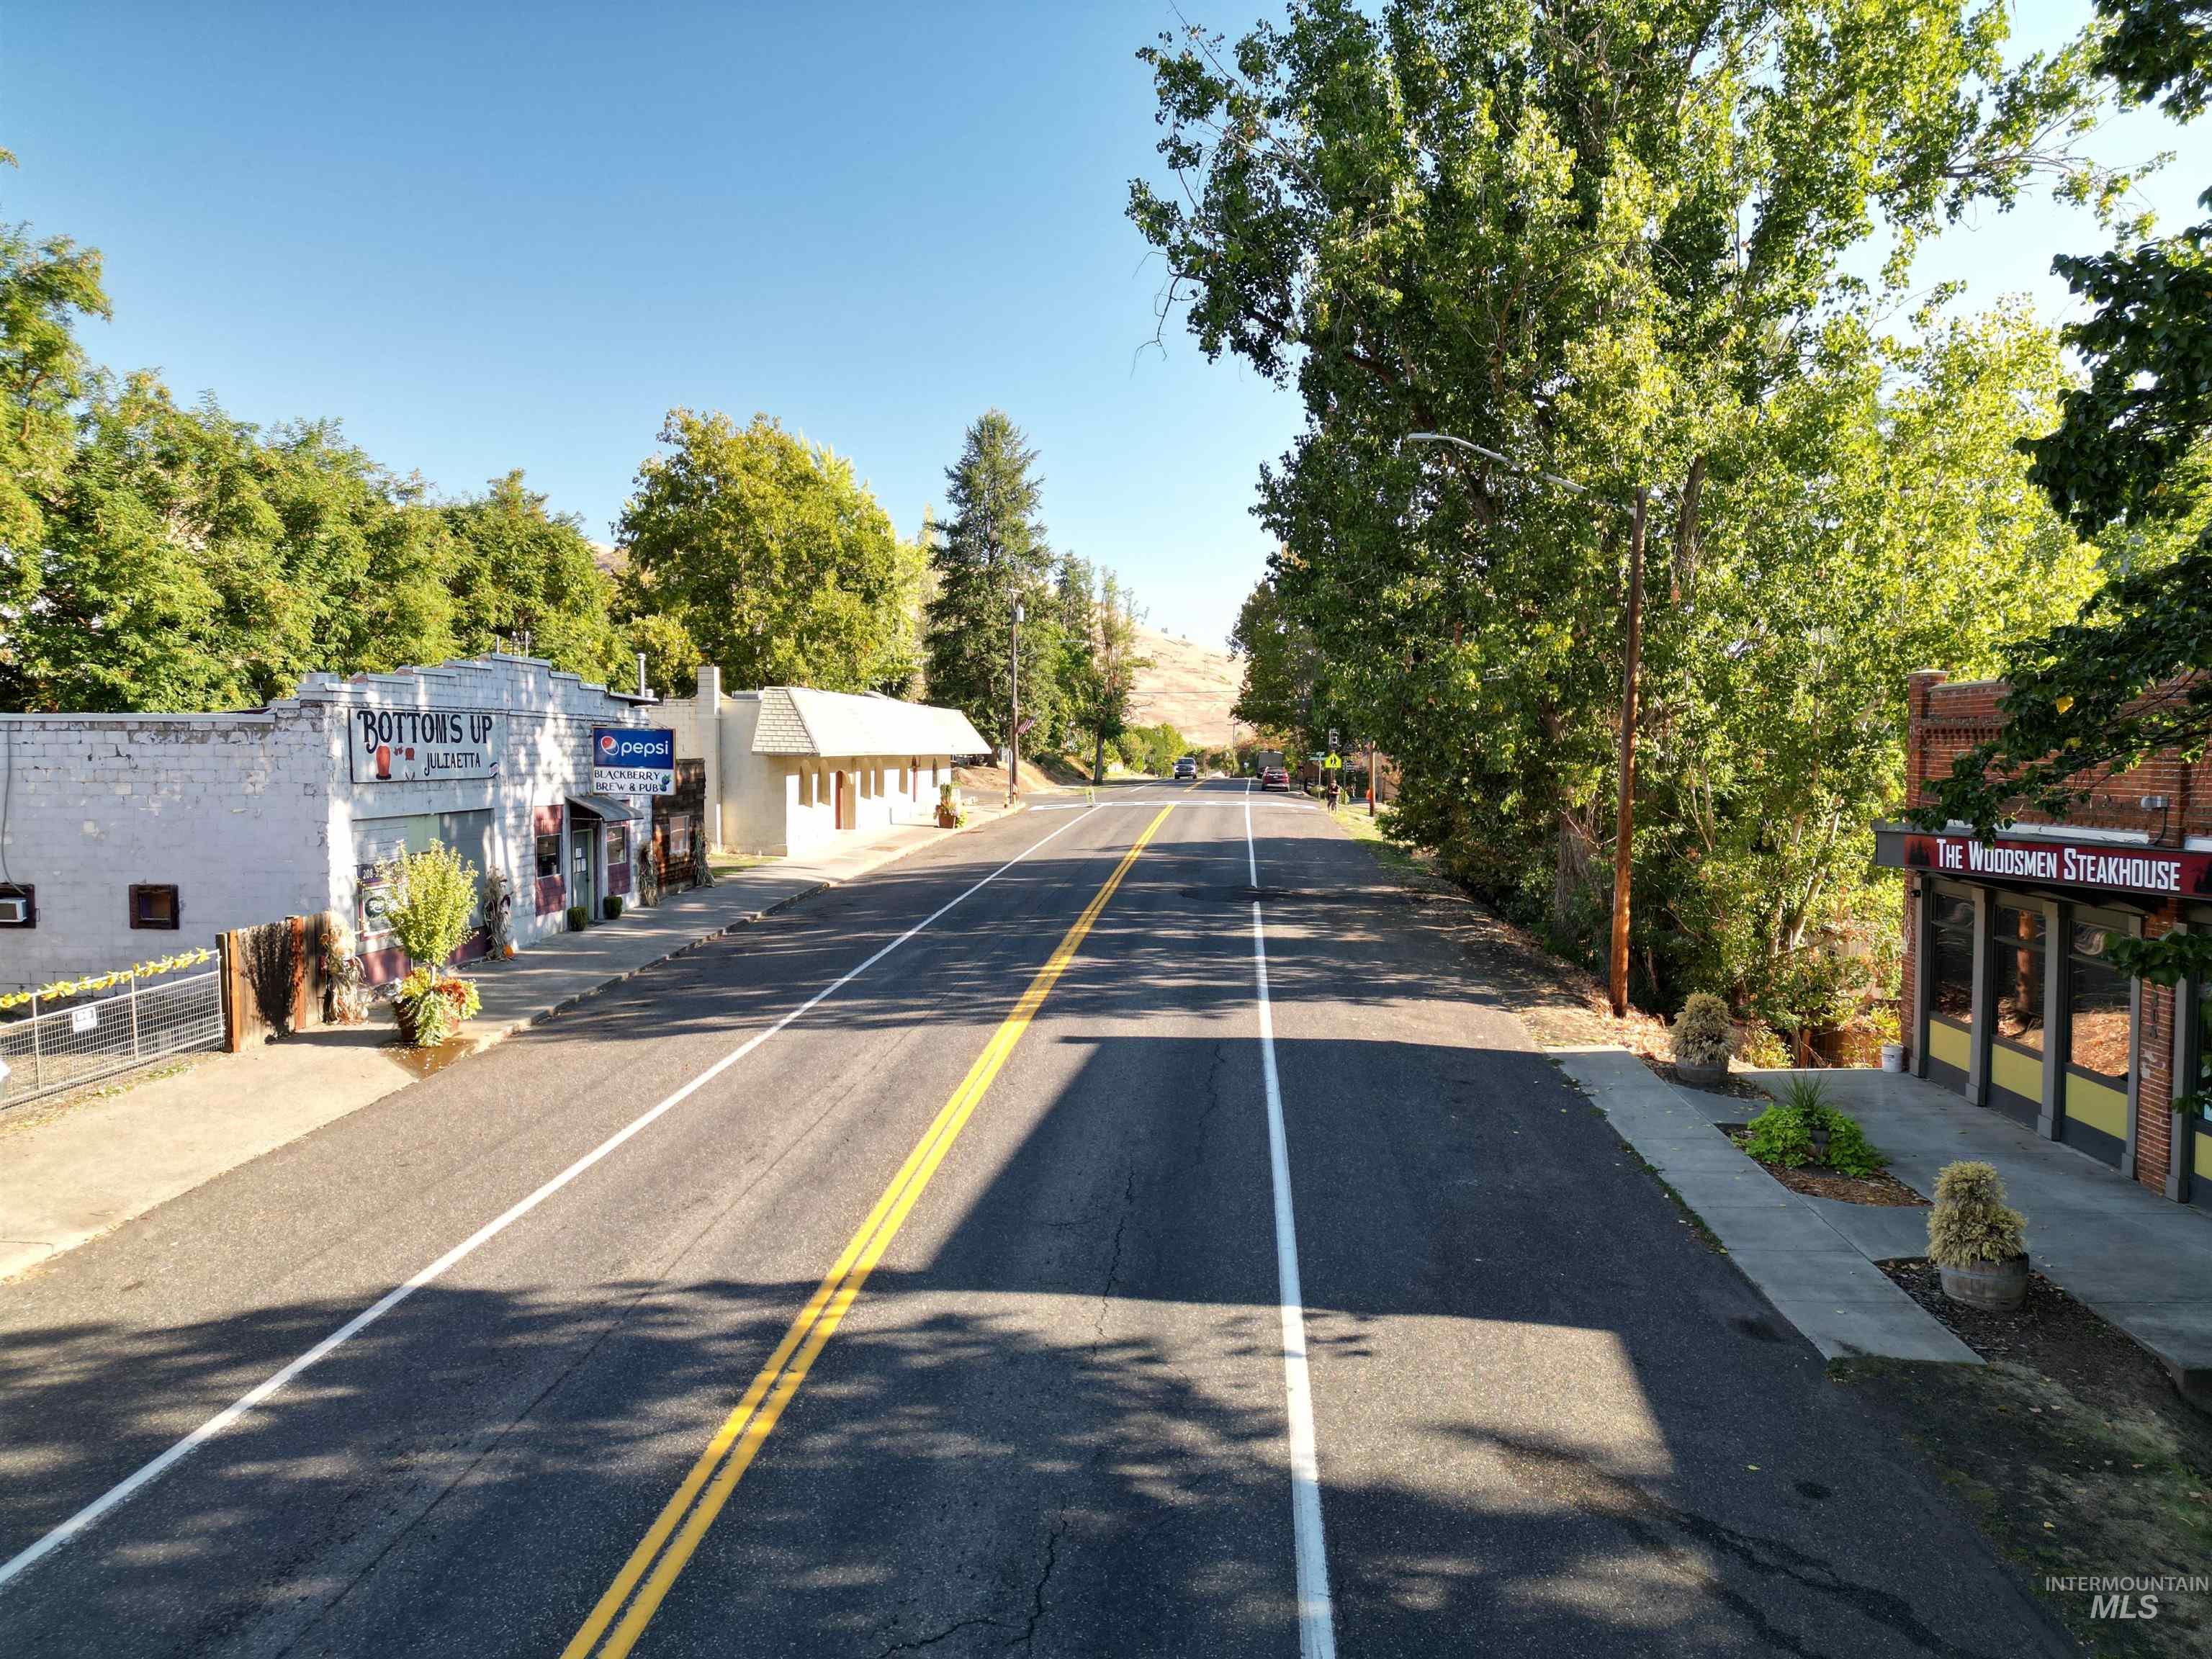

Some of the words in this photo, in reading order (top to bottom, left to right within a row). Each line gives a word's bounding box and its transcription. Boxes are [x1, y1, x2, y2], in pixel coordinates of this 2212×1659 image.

[357, 710, 463, 754] BOTTOM'S
[470, 715, 493, 744] UP
[621, 740, 668, 757] pepsi
[423, 752, 481, 777] JULIAETTA
[594, 770, 660, 781] BLACKBERRY
[595, 781, 626, 793] BREW
[629, 783, 636, 792] &
[639, 783, 659, 793] PUB
[1936, 838, 1964, 870] THE
[1968, 840, 2057, 878] WOODSMEN
[2063, 848, 2181, 891] STEAKHOUSE
